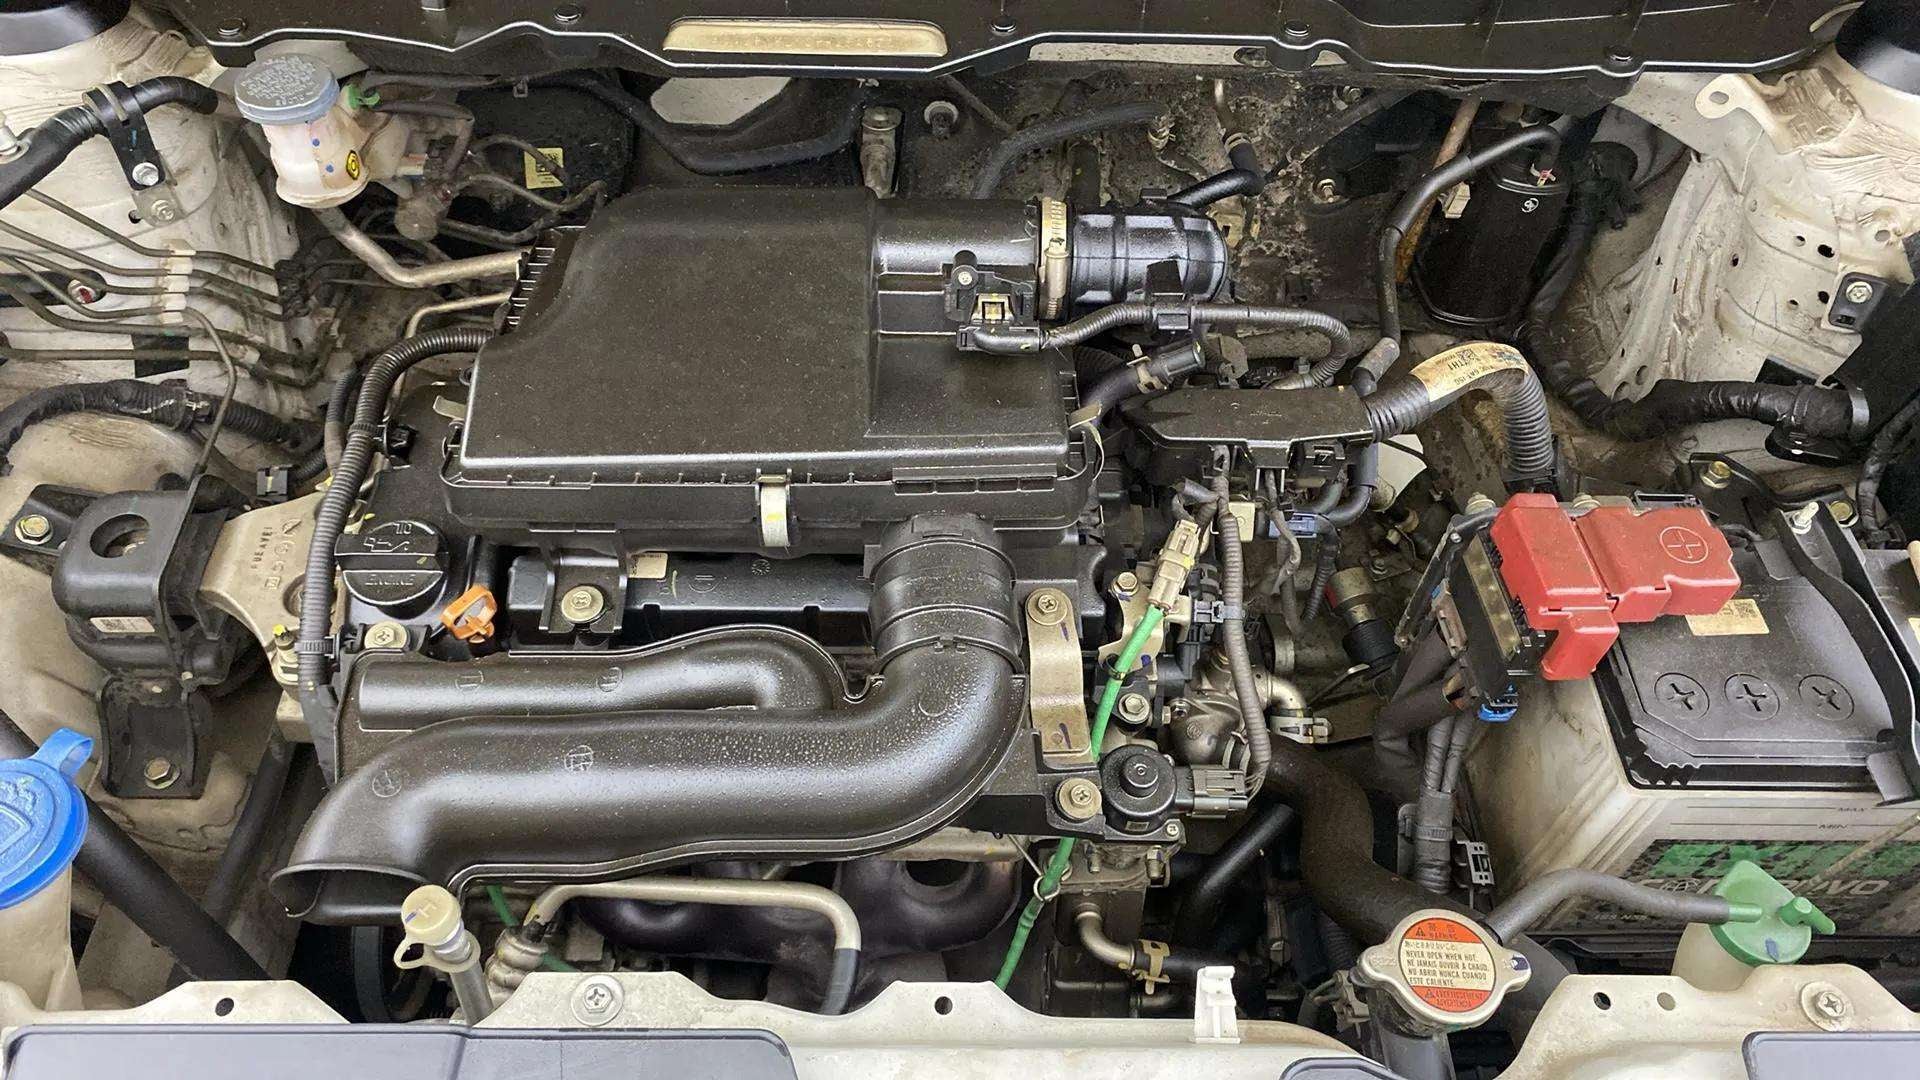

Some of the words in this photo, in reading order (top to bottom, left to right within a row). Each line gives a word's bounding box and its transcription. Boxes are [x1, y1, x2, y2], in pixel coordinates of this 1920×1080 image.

[393, 522, 413, 535] OIL
[365, 574, 416, 586] ENGINE
[1429, 932, 1458, 940] WARNING
[1406, 950, 1424, 958] NEVER
[1417, 960, 1437, 968] JAMAIS
[1440, 961, 1459, 970] OUVRIR
[1420, 969, 1437, 977] ABRIR
[1440, 970, 1460, 978] NUNCA
[1462, 972, 1487, 980] CUANDO
[1410, 977, 1423, 985] ESTE
[1427, 978, 1454, 987] CALIENTE
